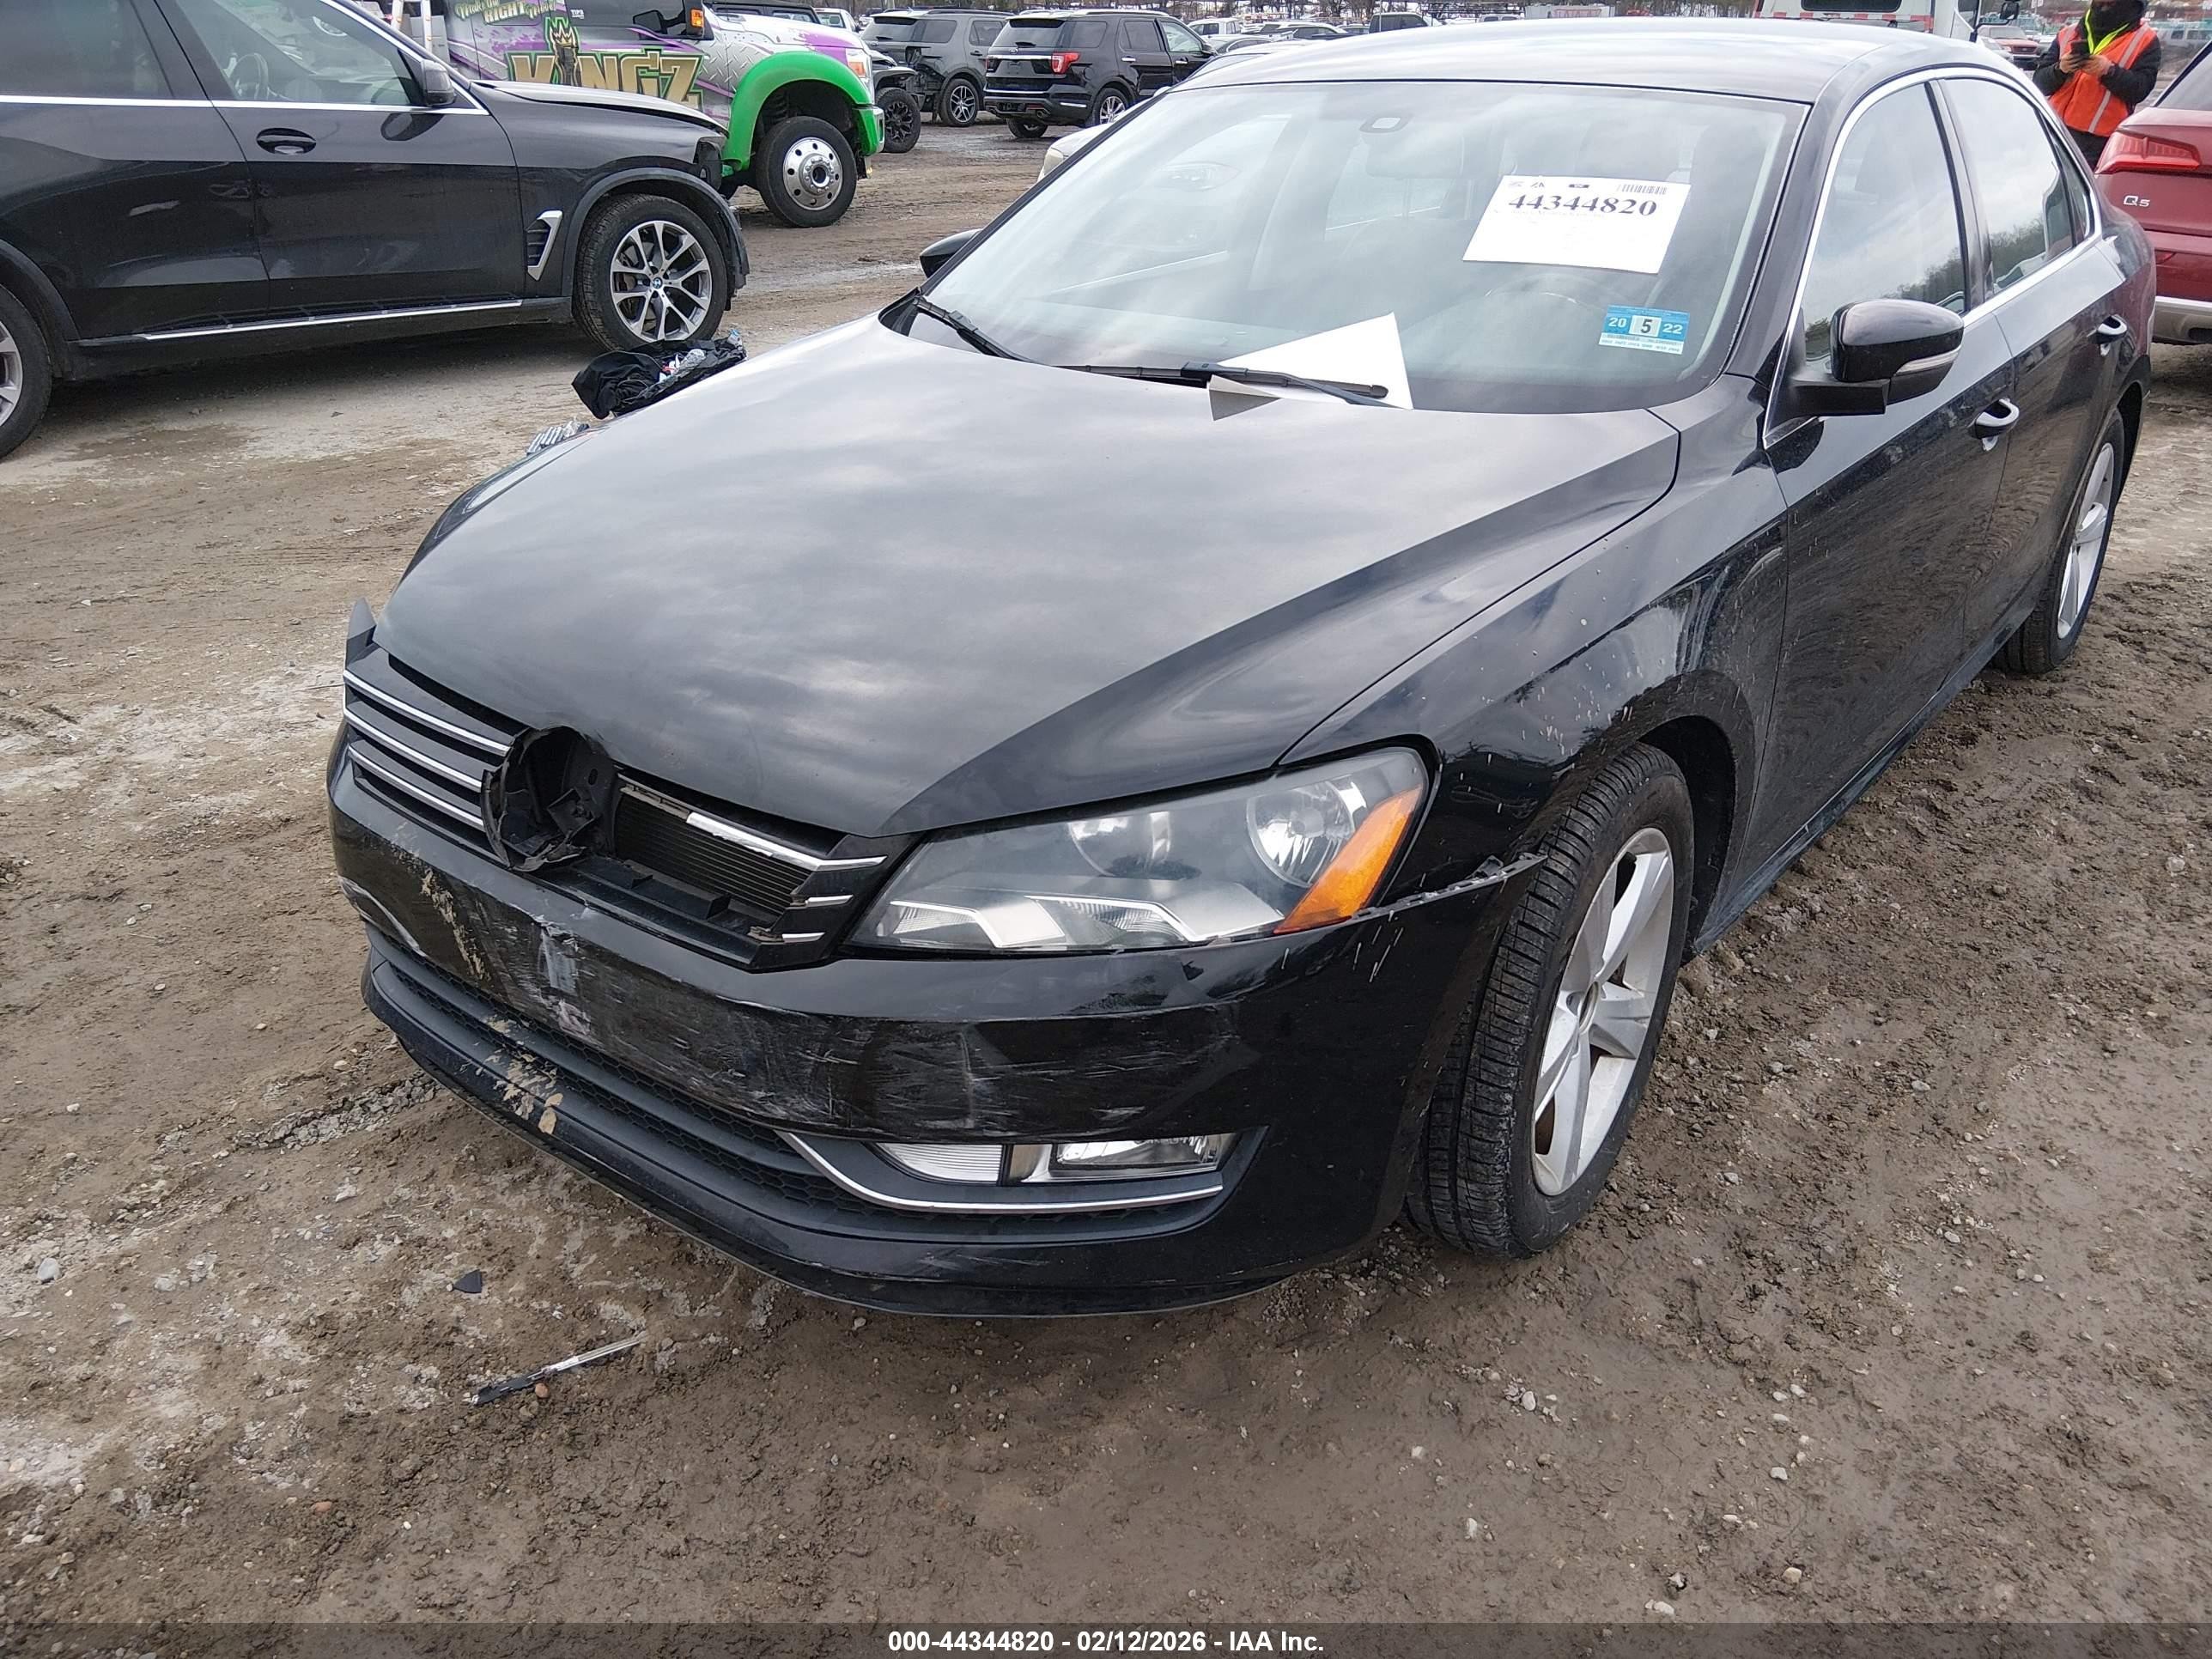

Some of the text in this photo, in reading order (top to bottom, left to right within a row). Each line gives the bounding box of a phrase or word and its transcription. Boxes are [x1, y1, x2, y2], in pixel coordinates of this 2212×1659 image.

[483, 2, 525, 23] RIGHT
[1509, 194, 1657, 216] 44344820
[2123, 195, 2150, 207] Q5
[1608, 317, 1683, 335] 20 5 22
